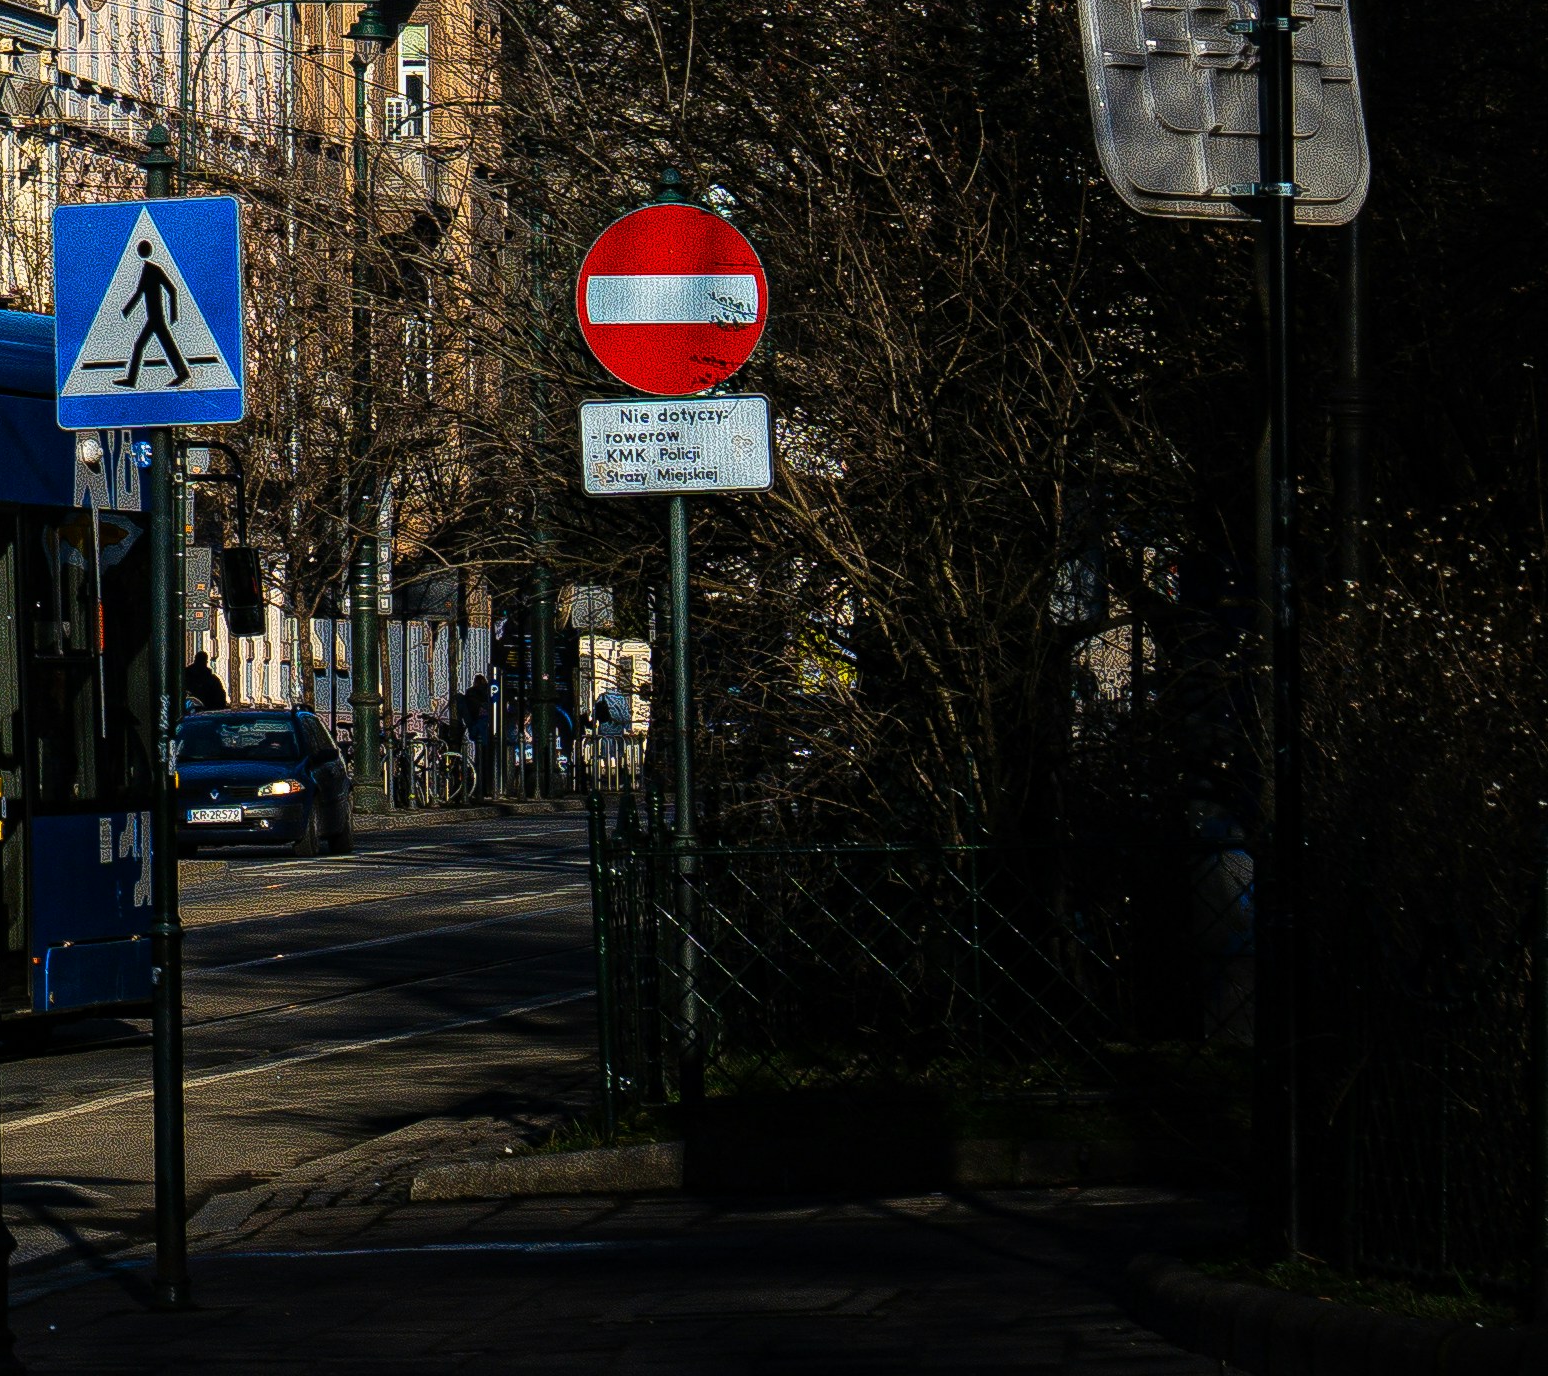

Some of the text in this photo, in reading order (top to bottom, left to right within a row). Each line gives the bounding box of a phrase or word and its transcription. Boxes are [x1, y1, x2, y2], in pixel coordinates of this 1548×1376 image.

[620, 409, 650, 424] Nie
[606, 428, 680, 445] rowerów
[659, 446, 700, 464] Policji
[657, 466, 718, 484] Miejskiej
